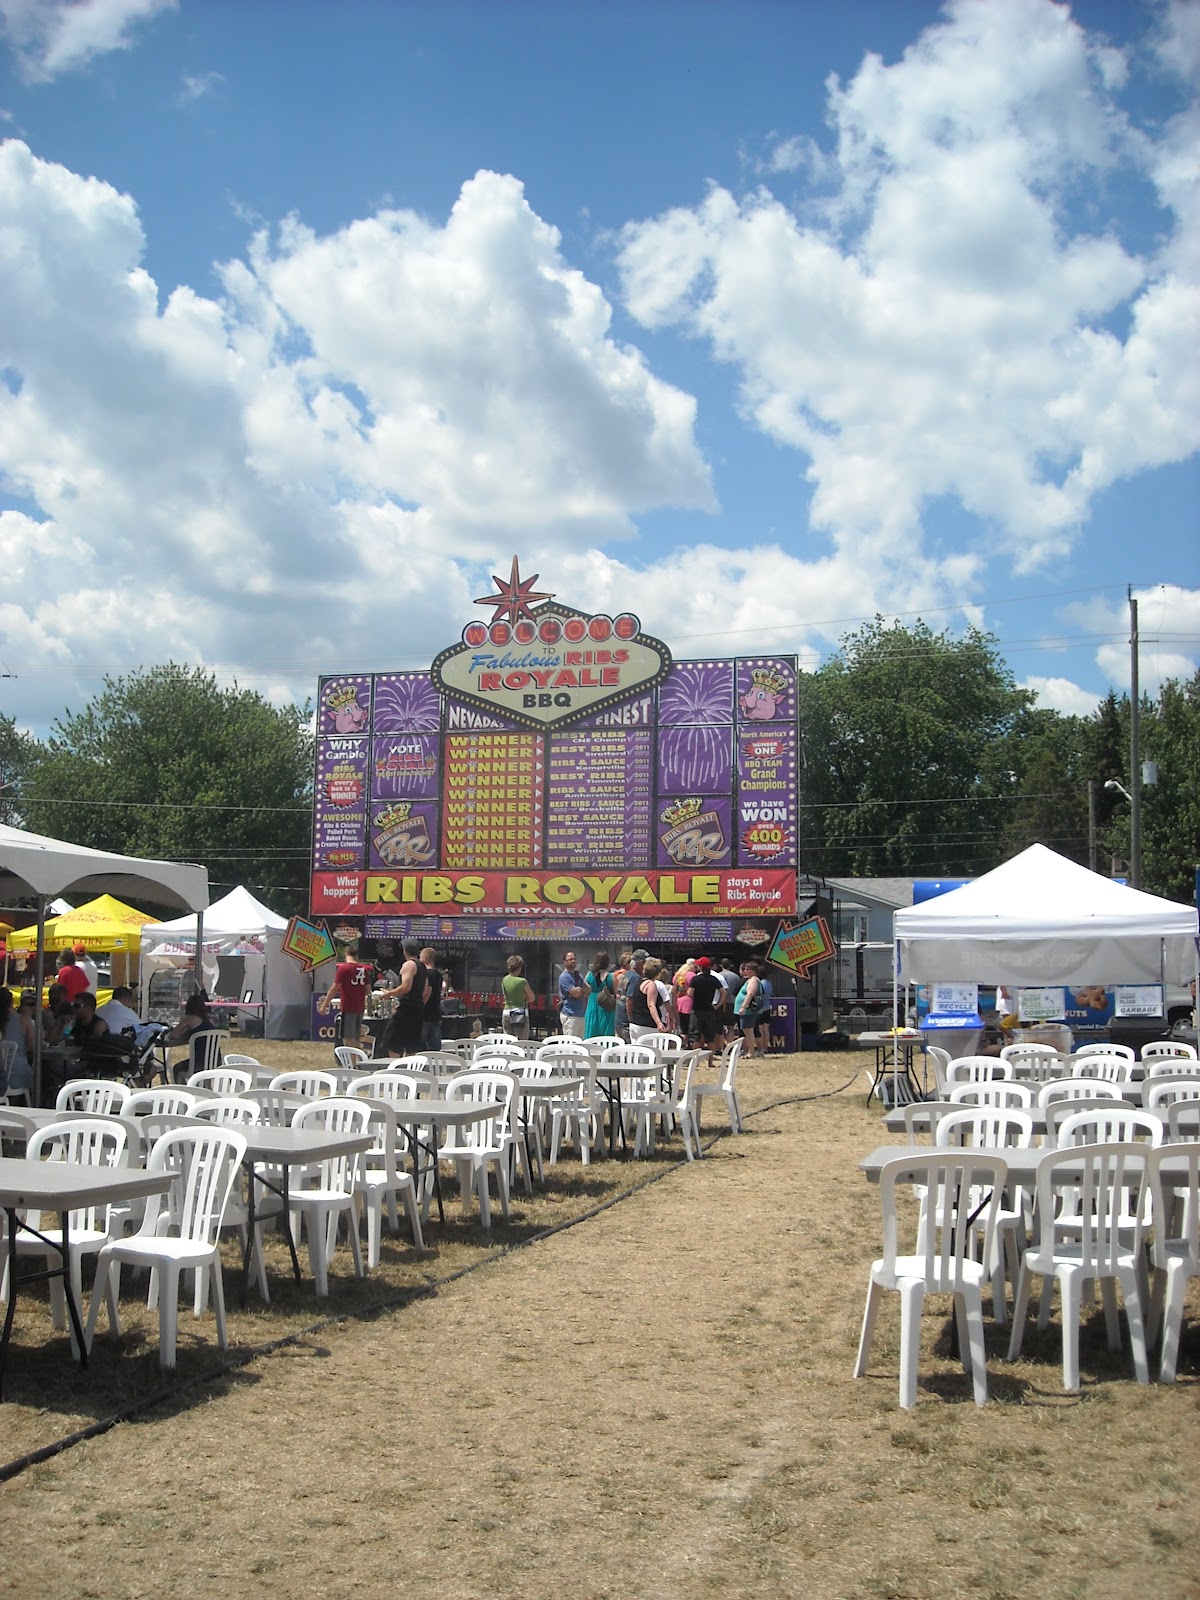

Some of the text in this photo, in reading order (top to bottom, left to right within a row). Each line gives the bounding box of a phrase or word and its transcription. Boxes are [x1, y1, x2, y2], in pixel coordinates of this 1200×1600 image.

[468, 618, 633, 643] WELCOME
[542, 647, 556, 655] TO
[469, 649, 630, 673] Fabulous RIBS
[478, 667, 621, 692] ROYALE
[523, 692, 572, 708] BBQ
[595, 697, 651, 726] FINEST
[330, 740, 362, 750] WHY
[450, 735, 533, 746] WINNER
[389, 745, 421, 754] VOTE
[450, 748, 533, 759] WINNER
[754, 747, 776, 755] ONE
[326, 751, 365, 759] Gamble
[449, 762, 532, 772] WINNER
[325, 772, 363, 780] ROYALE
[751, 769, 776, 779] Grand
[449, 776, 532, 786] WINNER
[741, 780, 786, 792] Champions
[331, 792, 357, 800] WINNER
[448, 789, 531, 799] WINNER
[448, 803, 531, 813] WINNER
[741, 808, 787, 821] WON
[393, 819, 422, 833] ROYALE
[448, 816, 530, 826] WINNER
[665, 814, 715, 842] RIBS ROYALE
[447, 830, 530, 840] WINNER
[749, 830, 781, 842] 400
[446, 843, 530, 854] WINNER
[446, 857, 530, 867] WINNER
[337, 876, 358, 886] What
[727, 877, 763, 888] stays at
[323, 885, 358, 897] happens
[366, 874, 720, 904] RIBS ROYALE
[727, 888, 781, 901] Ribs Royale
[350, 896, 358, 905] at
[463, 906, 626, 914] RIBSROYALE.COM
[30, 937, 103, 947] KTTLE CORN
[779, 928, 816, 950] ORDER
[786, 941, 818, 961] HERE
